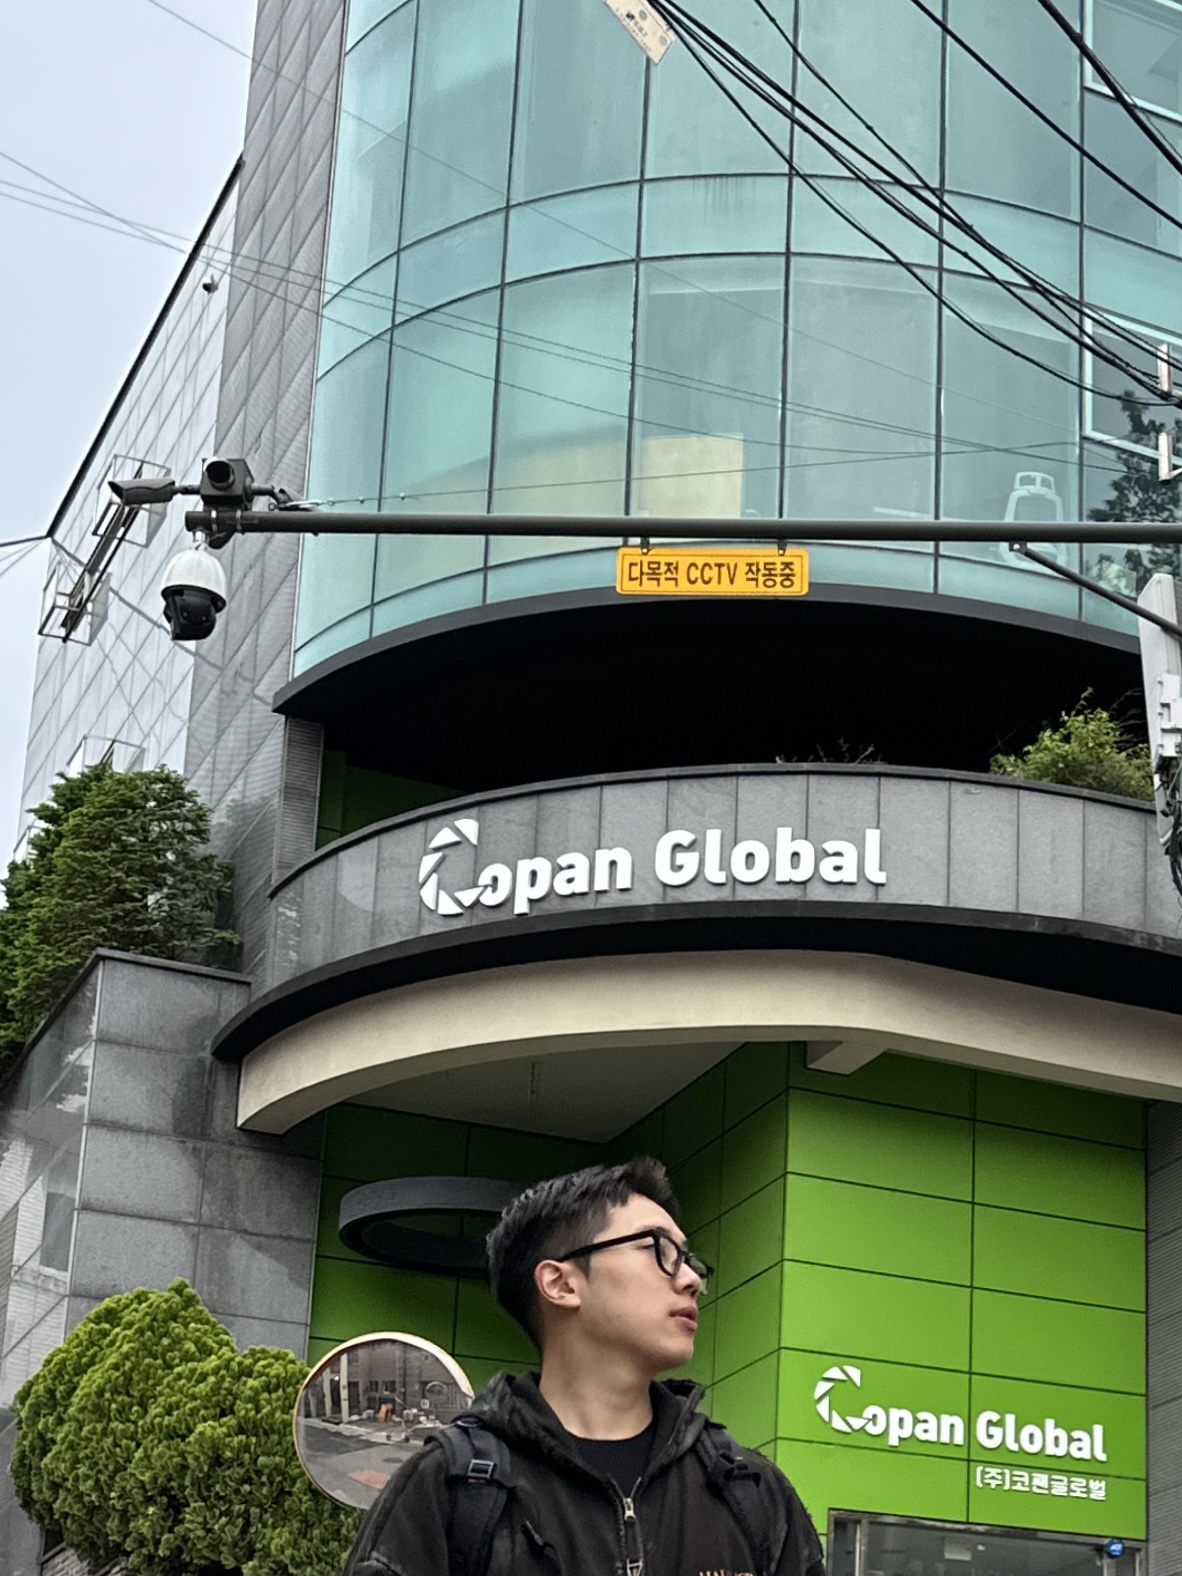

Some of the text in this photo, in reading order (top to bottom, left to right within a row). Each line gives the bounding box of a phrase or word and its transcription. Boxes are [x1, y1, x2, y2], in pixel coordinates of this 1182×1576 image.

[628, 559, 796, 589] 다목적 CCTV 작동중
[418, 818, 887, 916] Copan Global
[814, 1365, 1107, 1463] Copan Global
